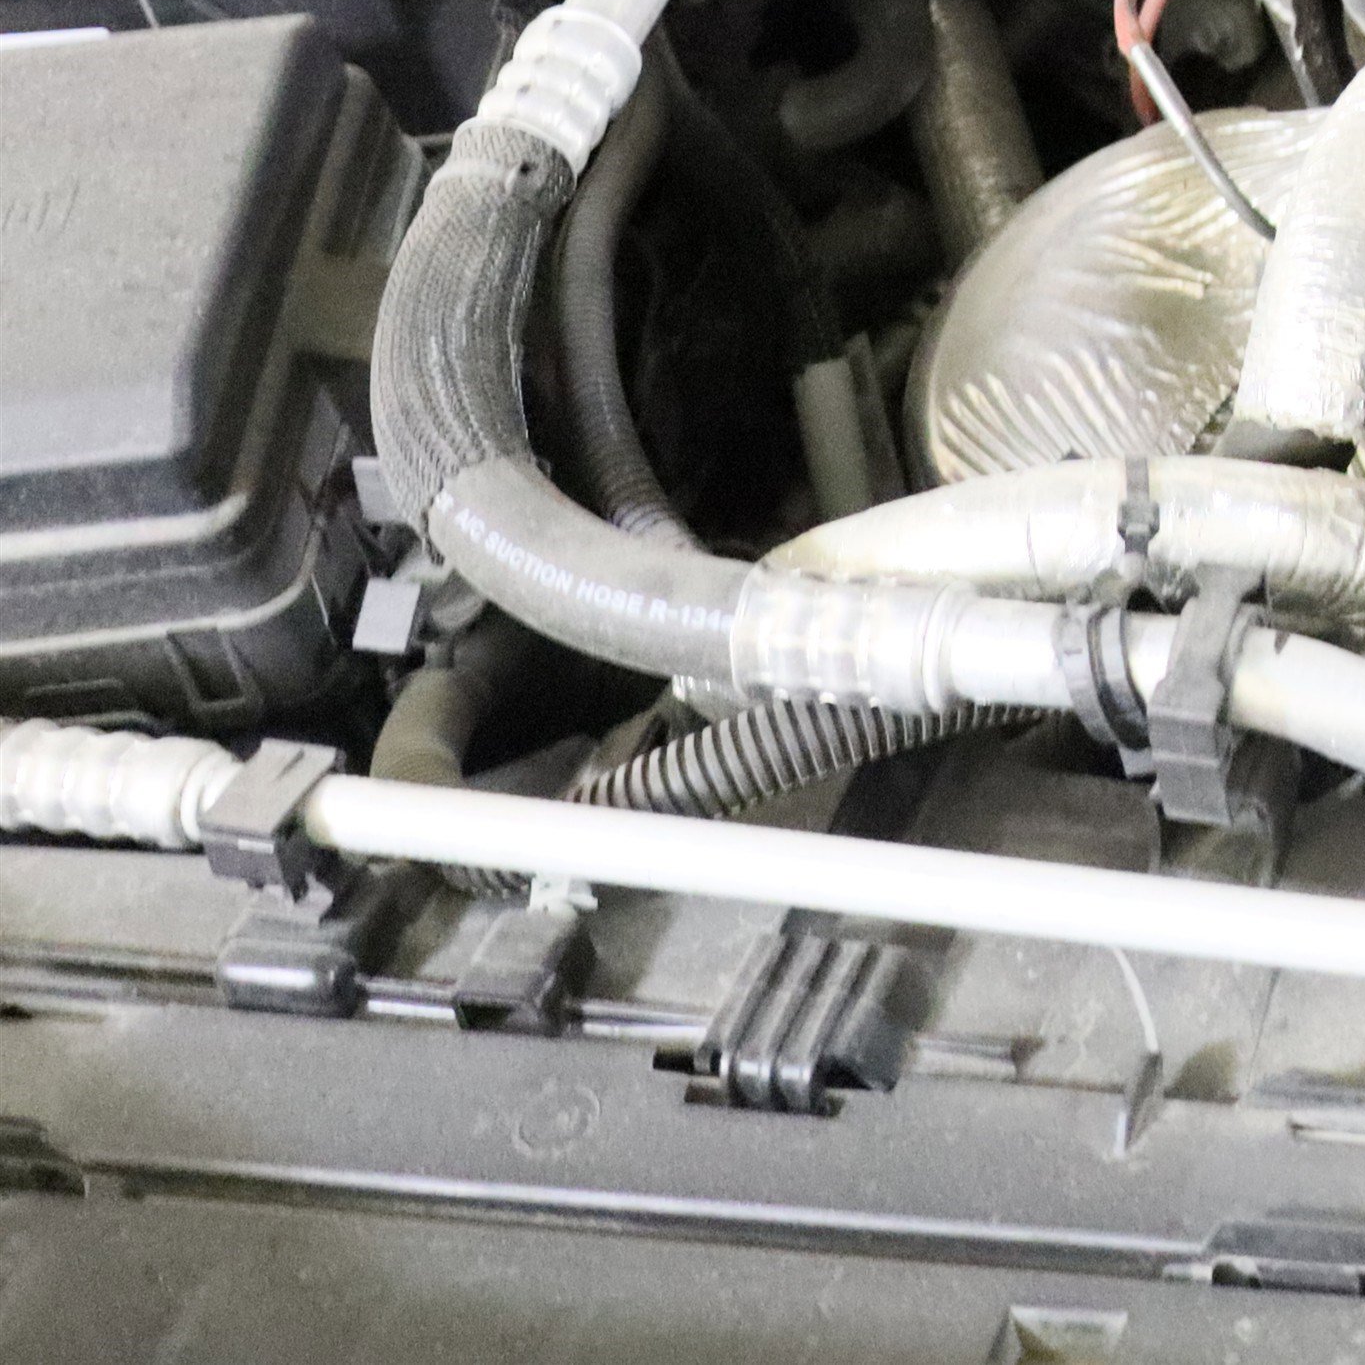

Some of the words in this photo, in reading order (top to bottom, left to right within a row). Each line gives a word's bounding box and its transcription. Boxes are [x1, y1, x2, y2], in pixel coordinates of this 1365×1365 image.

[455, 507, 486, 544] A/C
[484, 531, 575, 592] SUCTION
[576, 578, 645, 615] HOSE
